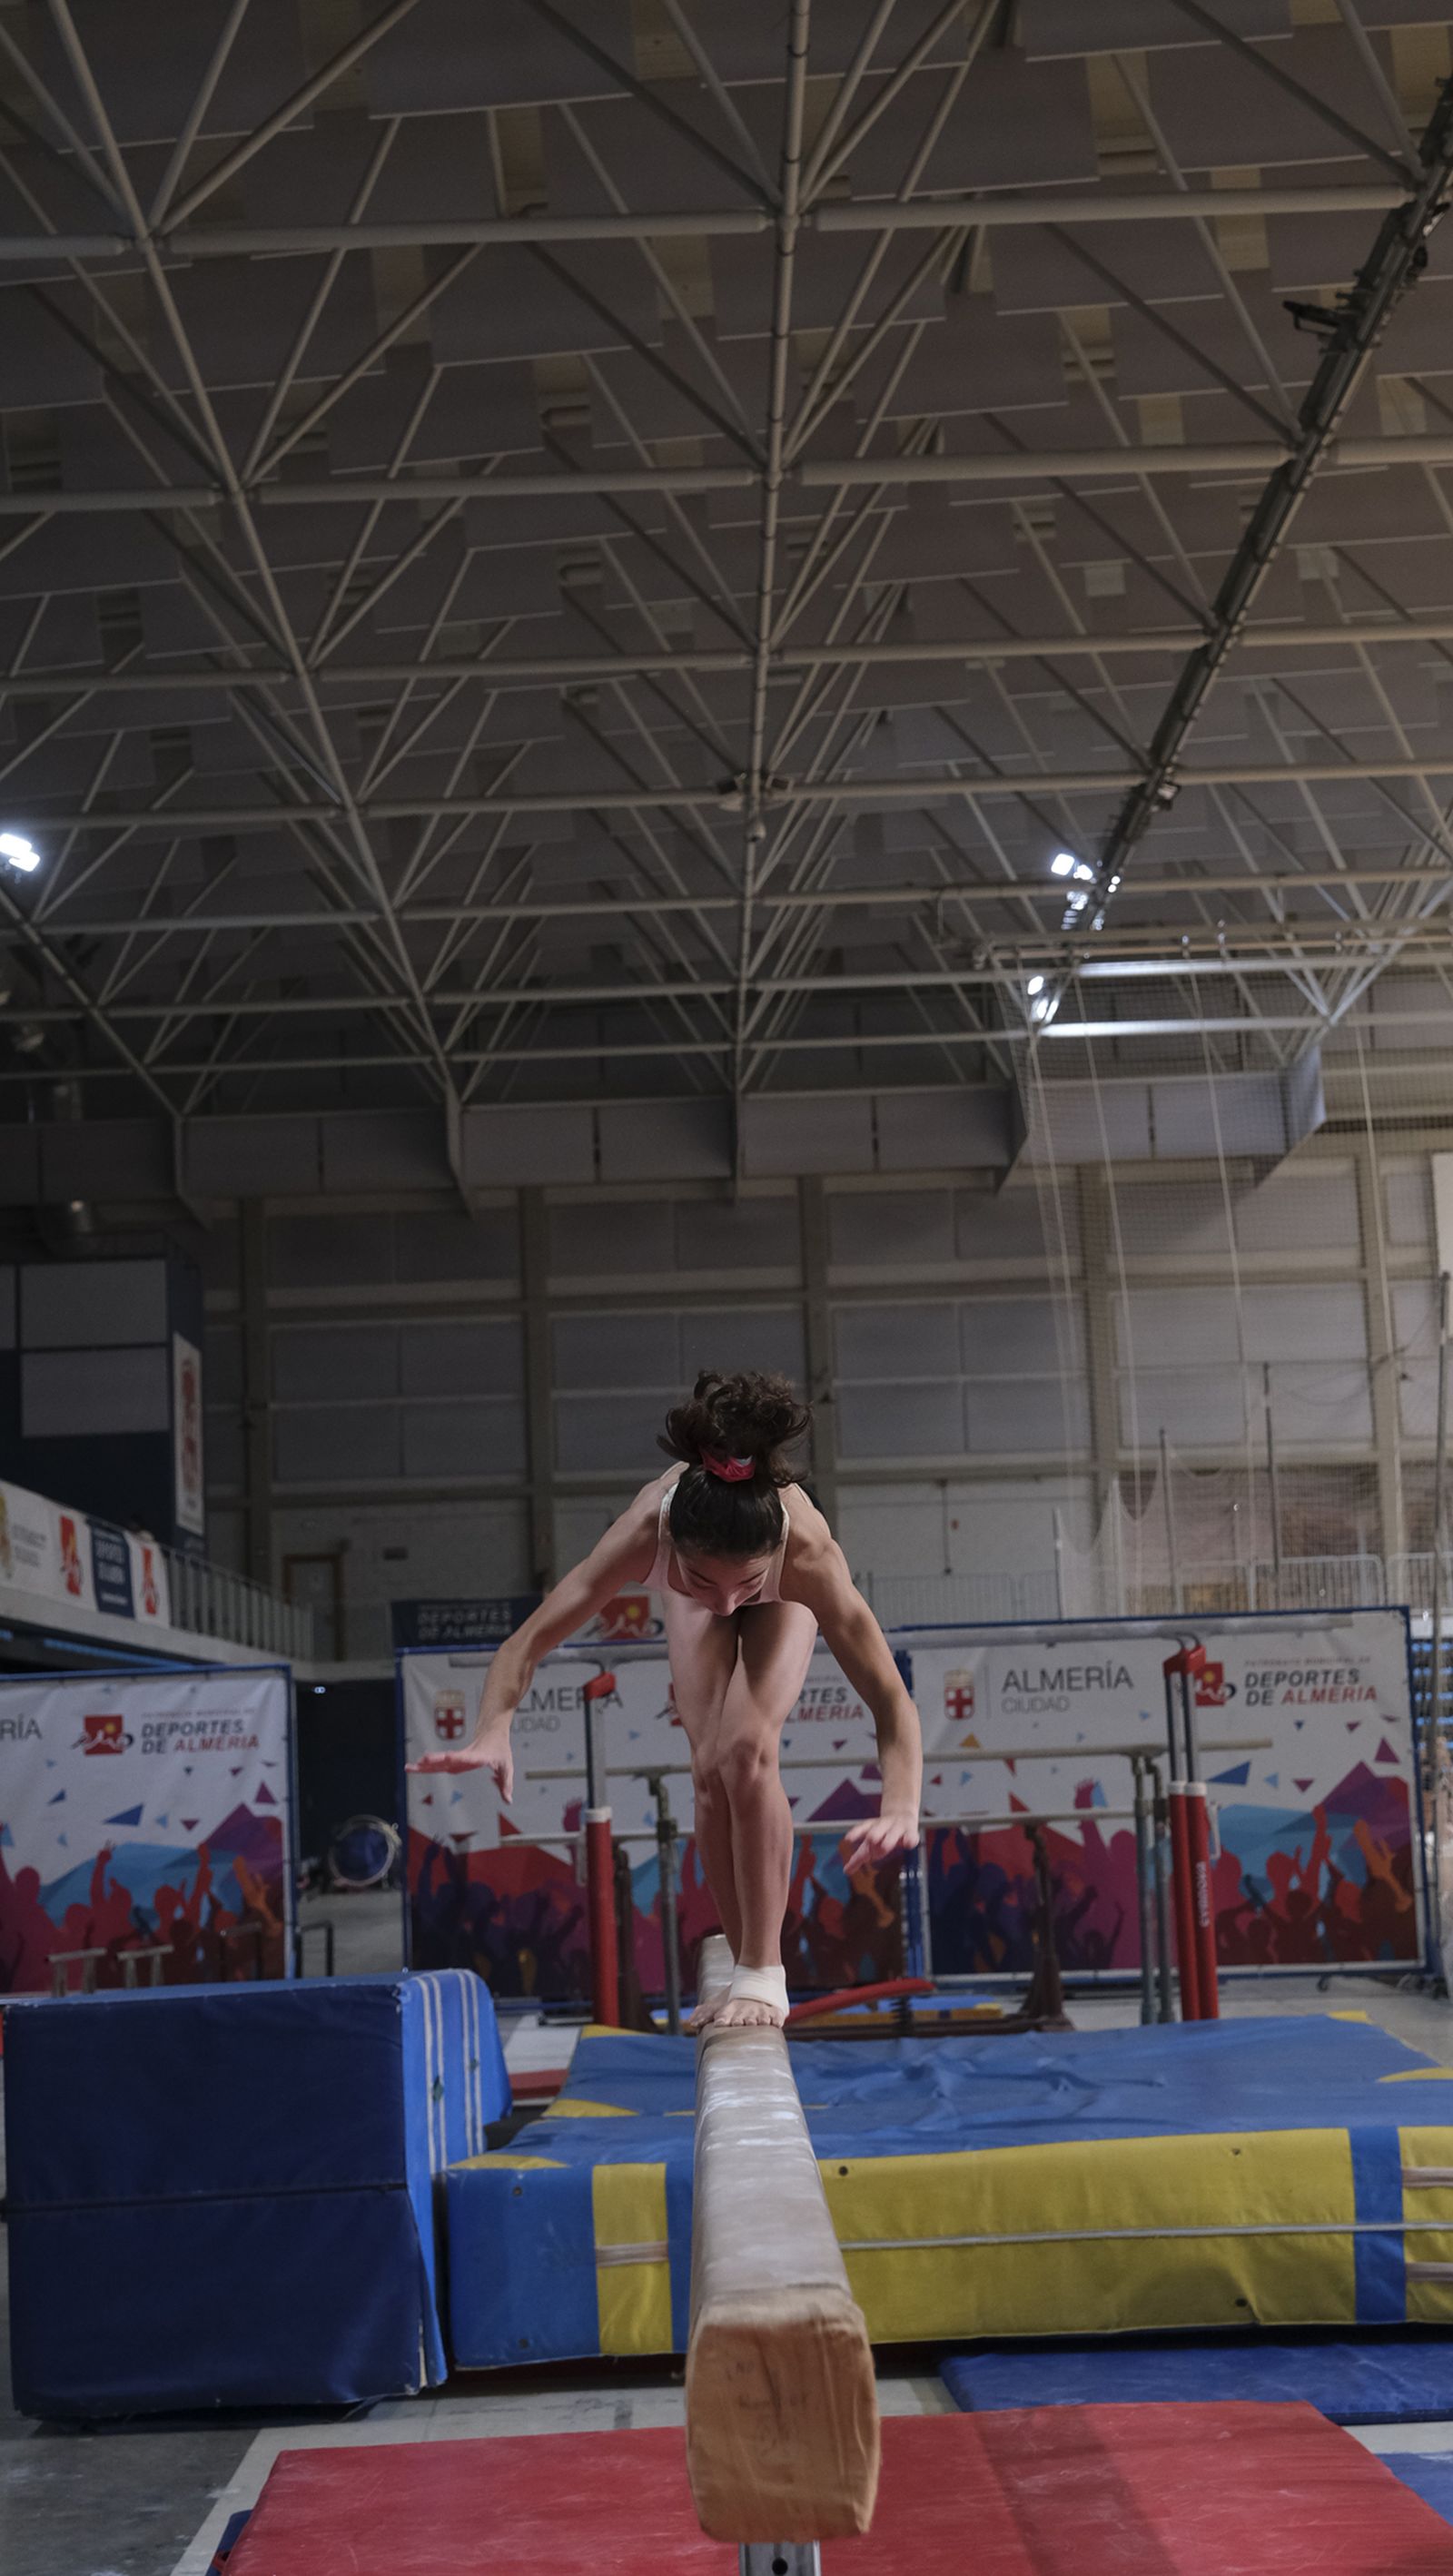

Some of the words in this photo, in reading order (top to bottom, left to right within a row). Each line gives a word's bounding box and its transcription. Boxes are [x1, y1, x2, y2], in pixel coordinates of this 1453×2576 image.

[1002, 1661, 1133, 1693] ALMERÍA
[1245, 1668, 1361, 1688] DEPORTES
[1002, 1696, 1071, 1714] CIUDAD
[1245, 1688, 1275, 1707] DE
[1281, 1685, 1379, 1705] ALMERIA
[141, 1719, 244, 1739] DEPORTES
[141, 1738, 167, 1755] DE
[173, 1733, 261, 1753] ALMERIA
